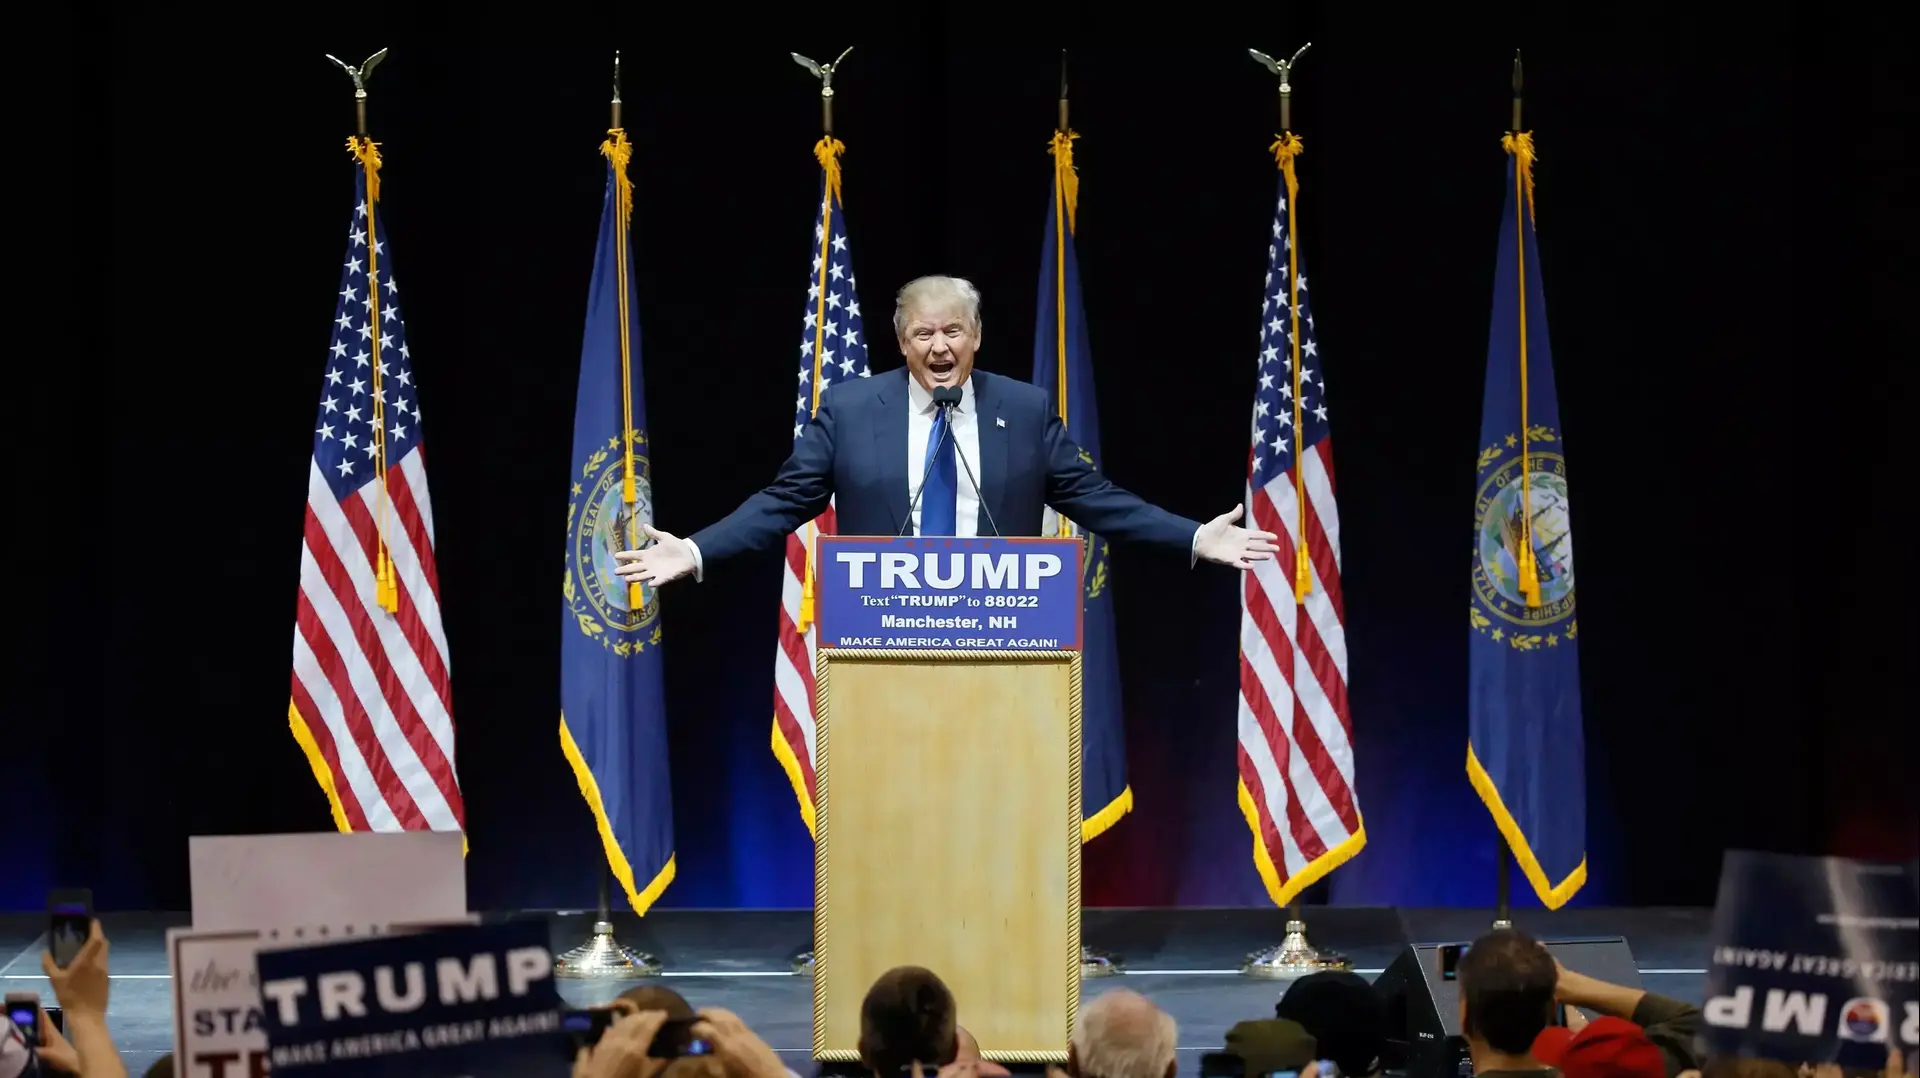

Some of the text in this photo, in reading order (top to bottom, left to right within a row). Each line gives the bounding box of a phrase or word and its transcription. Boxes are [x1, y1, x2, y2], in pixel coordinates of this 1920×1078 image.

[1496, 471, 1511, 488] OF
[1521, 459, 1543, 471] HE
[583, 473, 614, 537] SEAL OF
[836, 552, 1062, 590] TRUMP
[585, 571, 605, 607] 1776
[860, 595, 890, 607] Text
[967, 595, 981, 608] to
[984, 596, 1039, 608] 88022
[881, 615, 1017, 631] Manchester, NH
[840, 637, 1058, 648] MAKE AMERICA GREAT AGAIN!
[263, 945, 552, 1028] TRUMP
[1859, 960, 1919, 983] ERICA
[194, 1006, 264, 1036] STA
[1703, 985, 1919, 1046] UMP
